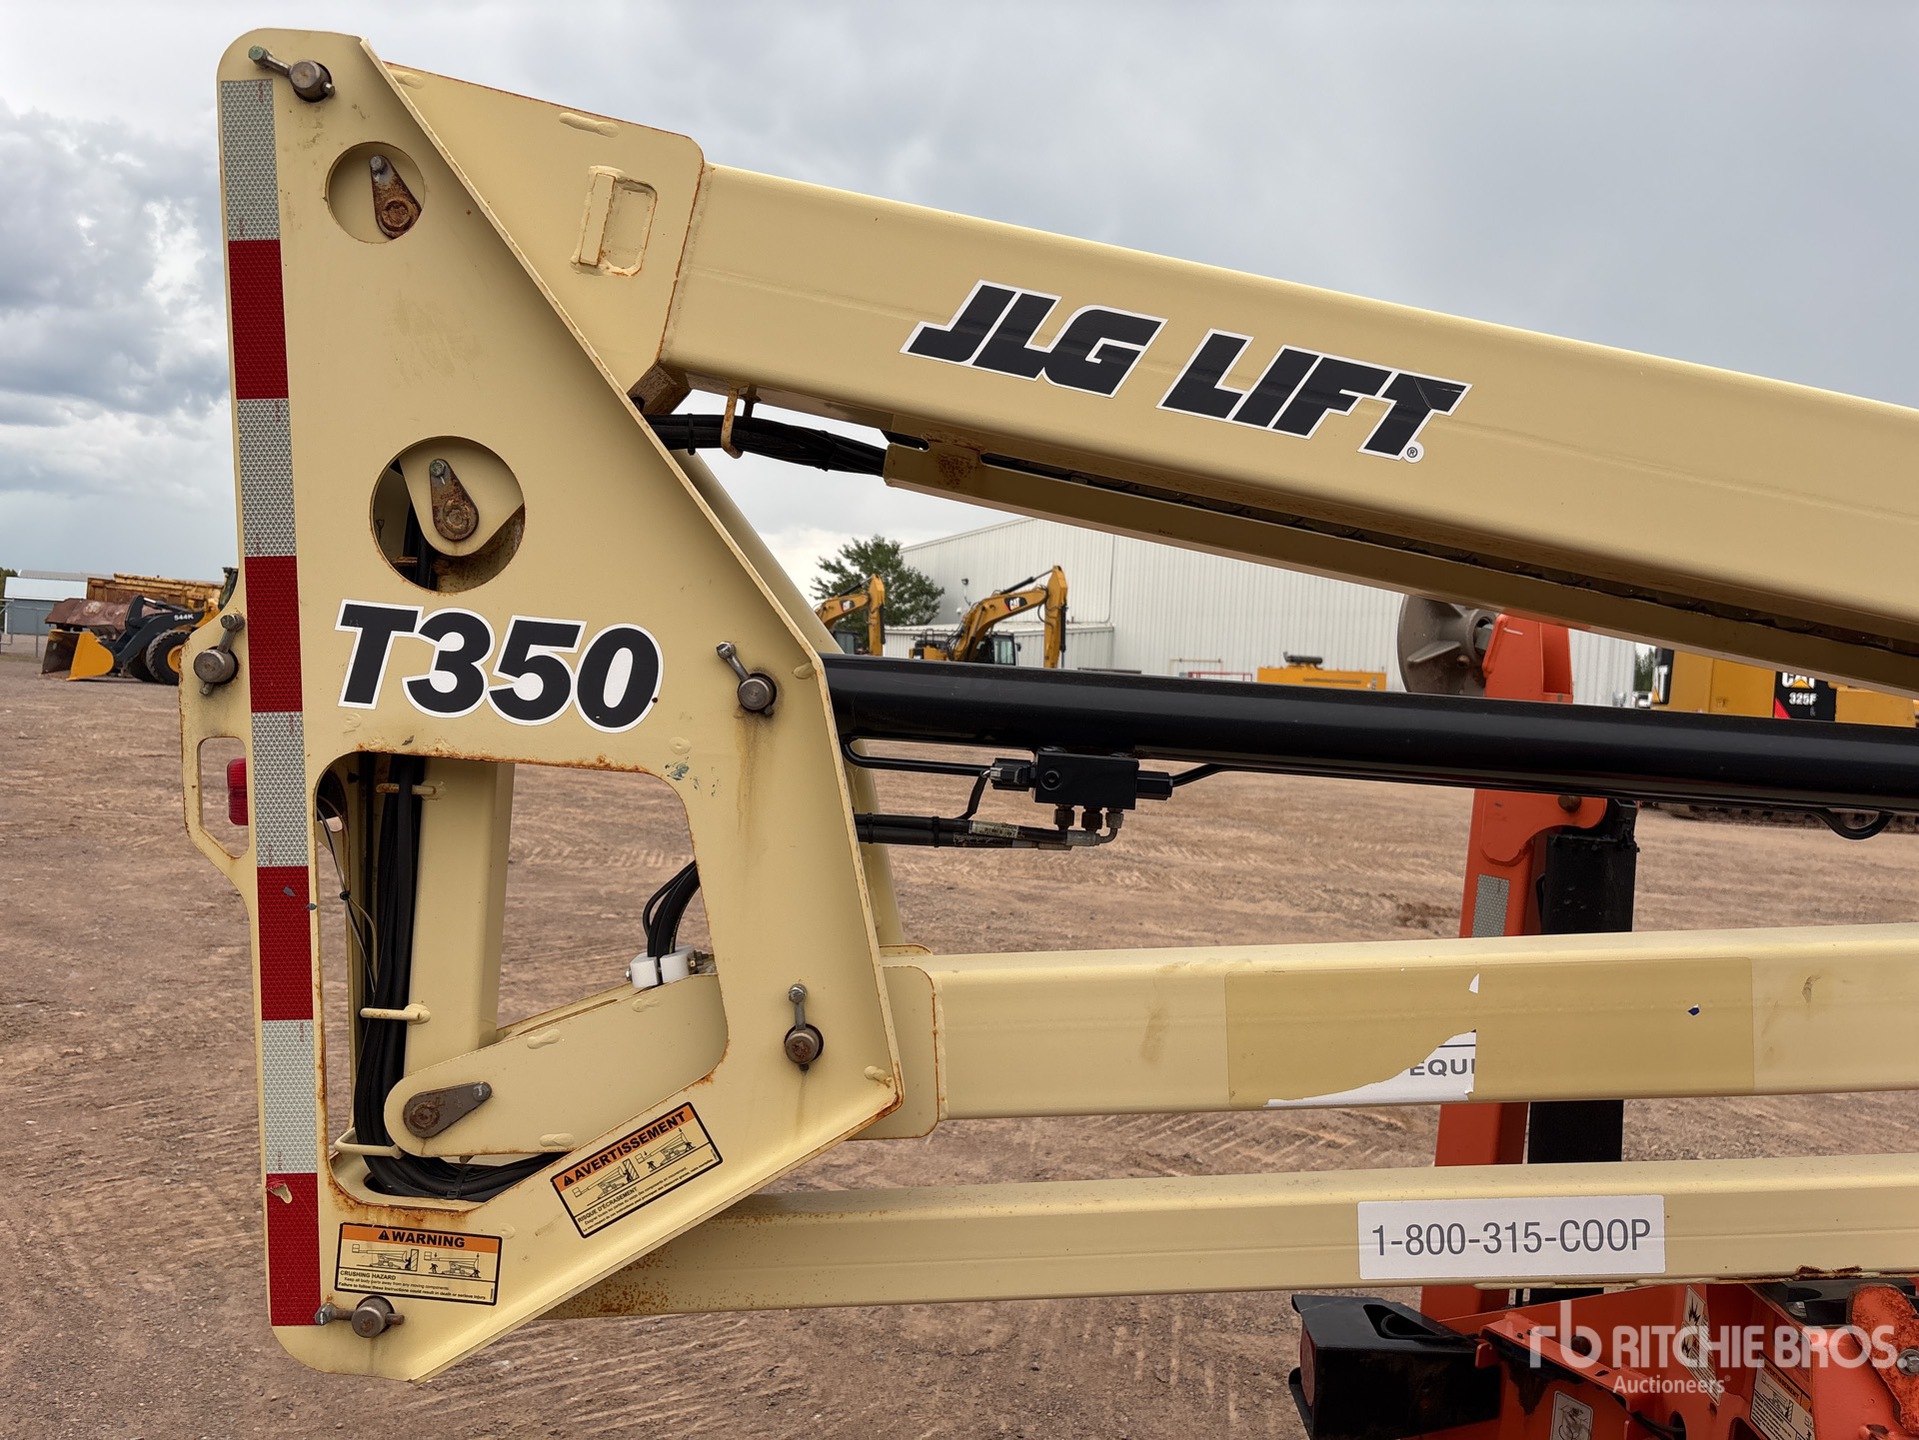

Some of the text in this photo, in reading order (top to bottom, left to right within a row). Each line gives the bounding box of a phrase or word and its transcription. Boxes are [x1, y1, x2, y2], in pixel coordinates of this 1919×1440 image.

[900, 280, 1472, 461] JLG LIFT
[335, 599, 663, 733] T350
[1789, 692, 1817, 705] 325F
[573, 1110, 686, 1182] AVERTISSEMENT
[577, 1208, 597, 1223] RISQUE
[392, 1231, 465, 1248] WARNING
[1372, 1218, 1651, 1256] 1-800-315-COOP
